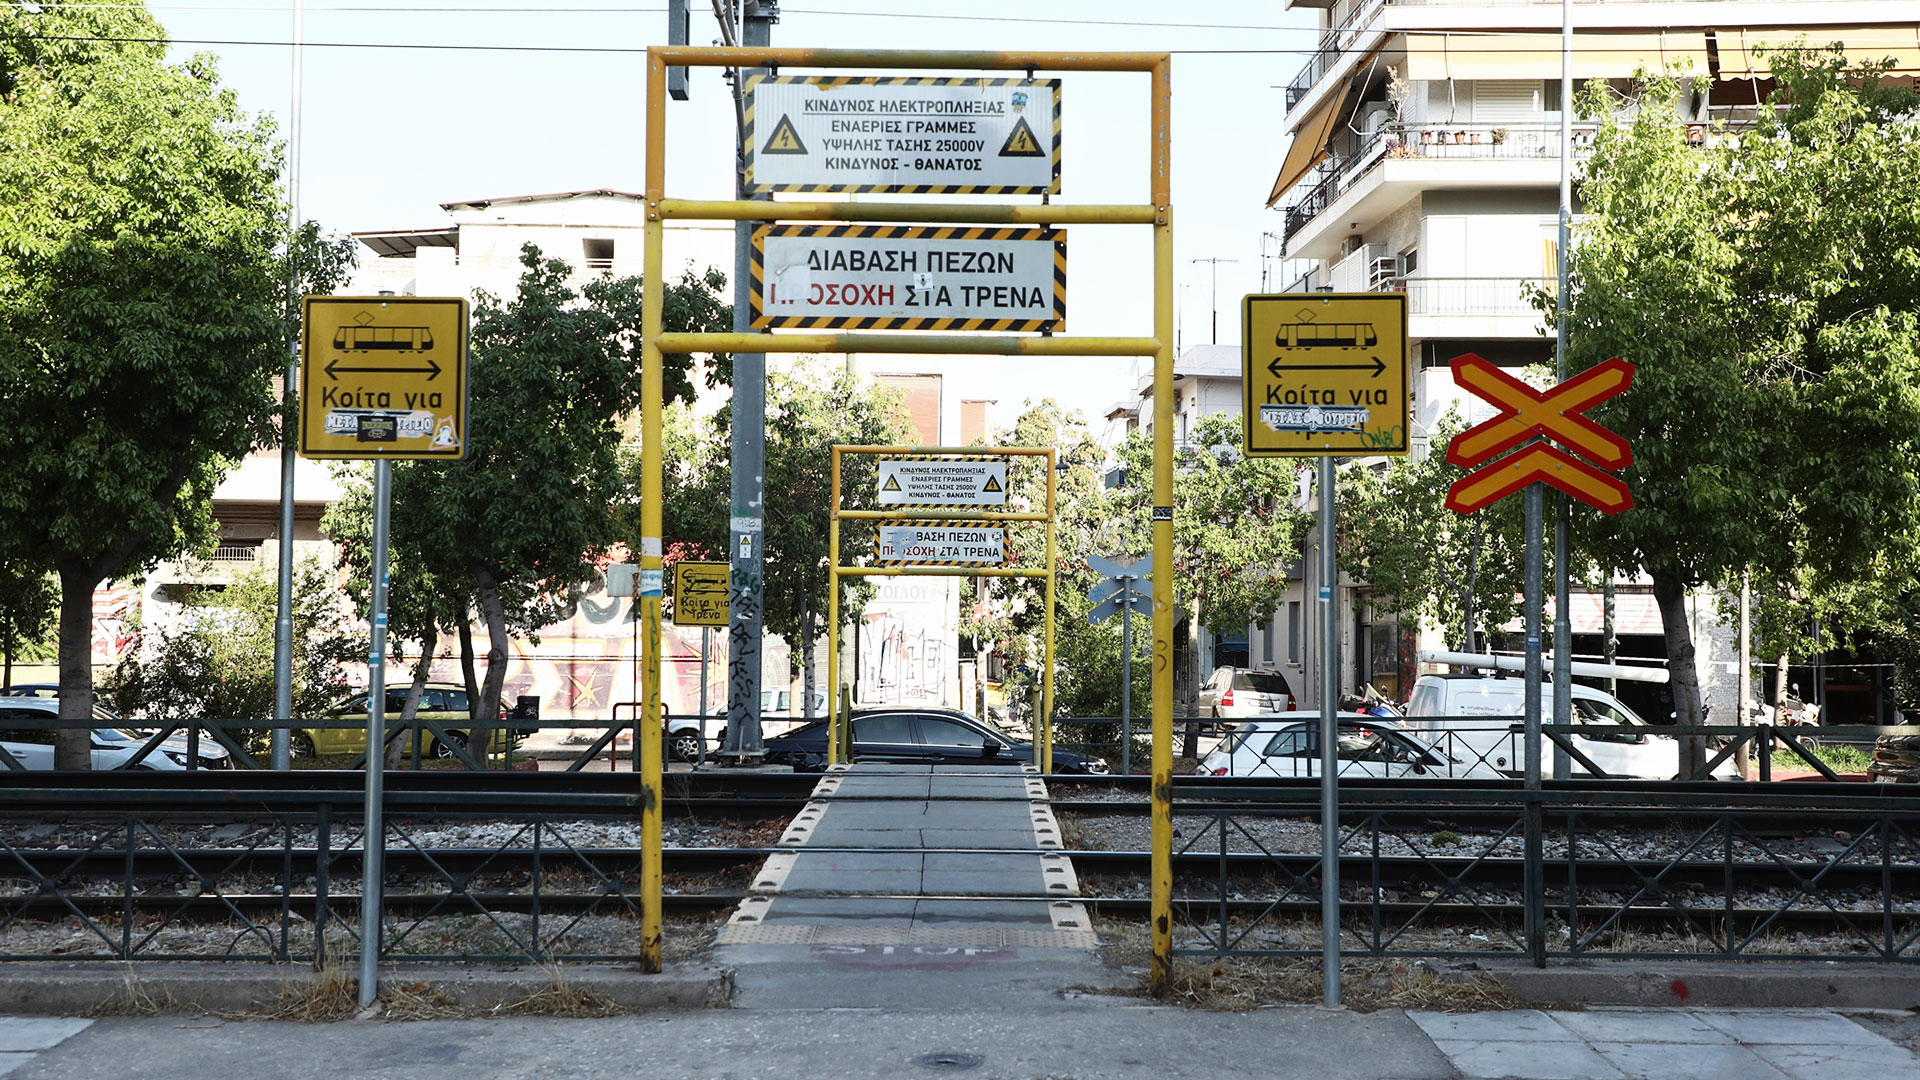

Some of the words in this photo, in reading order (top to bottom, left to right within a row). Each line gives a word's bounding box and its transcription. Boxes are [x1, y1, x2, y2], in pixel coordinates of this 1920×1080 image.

[805, 100, 874, 112] ΚΙΝΔΥΝΟΣ
[880, 101, 1004, 113] ΗΛΕΚΤΡΟΠΛΗΞΙΑΣ
[832, 121, 902, 133] ΕΝΑΕΡΙΕΣ
[907, 122, 976, 133] ΓΡΑΜΜΕΣ
[823, 139, 882, 151] ΥΨΗΛΗΣ
[887, 140, 931, 151] ΤΑΣΗΣ
[937, 140, 984, 152] 25000V
[826, 158, 898, 170] ΚΙΝΔΥΝΟΣ
[915, 159, 981, 170] ΘΑΝΑΤΟΣ
[808, 250, 916, 271] ΔΙΑΒΑΣΗ
[928, 252, 1013, 273] ΠΕΖΩΝ
[771, 284, 894, 305] ΟΣΟΧΗ
[905, 285, 952, 306] ΣΤΑ
[961, 286, 1045, 308] ΤΡΕΝΑ
[323, 387, 390, 408] Κοίτα
[405, 393, 441, 410] για
[1267, 385, 1335, 405] Κοίτα
[1350, 390, 1387, 405] για
[327, 415, 433, 431] ΜΕΤΑΥΡΓΕΙΟ
[949, 533, 987, 543] ΠΕΖΩΝ
[940, 547, 960, 557] ΣΤΑ
[964, 548, 1000, 558] ΤΡΕΝΑ
